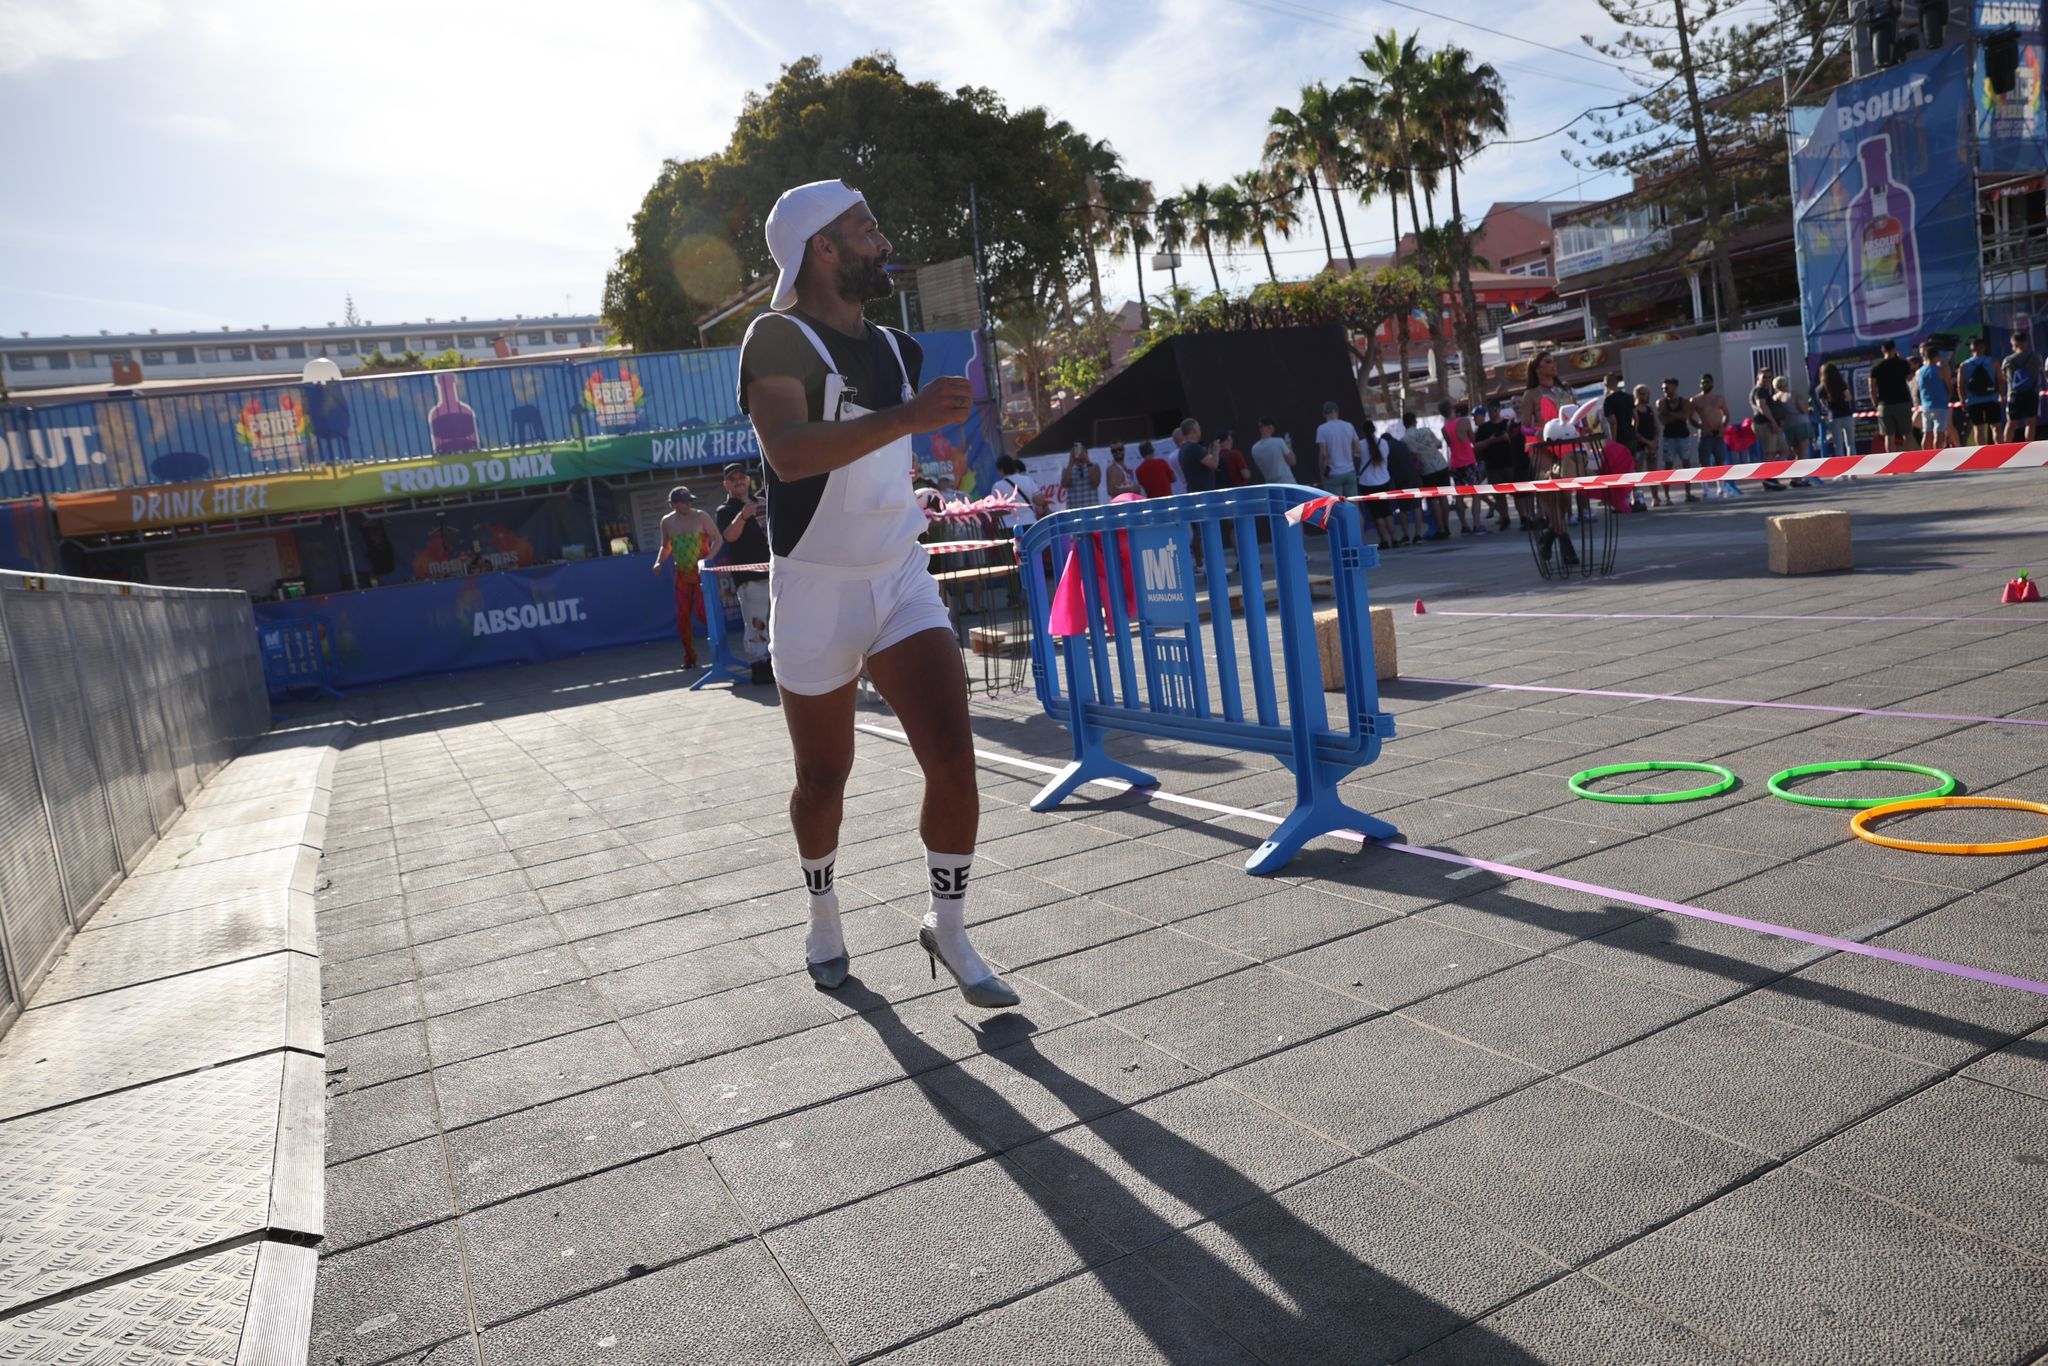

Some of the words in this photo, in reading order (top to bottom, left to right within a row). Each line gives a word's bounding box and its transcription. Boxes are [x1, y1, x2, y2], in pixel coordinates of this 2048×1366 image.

[593, 386, 634, 404] PRIDE
[651, 432, 708, 464] DRINK
[712, 429, 758, 457] HERE
[380, 462, 470, 494] PROUD
[471, 459, 506, 484] TO
[509, 453, 556, 480] MIX
[131, 486, 208, 523] DRINK
[212, 482, 270, 514] HERE
[1147, 592, 1184, 602] MASPALOMAS
[473, 598, 587, 637] ABSOLUT.
